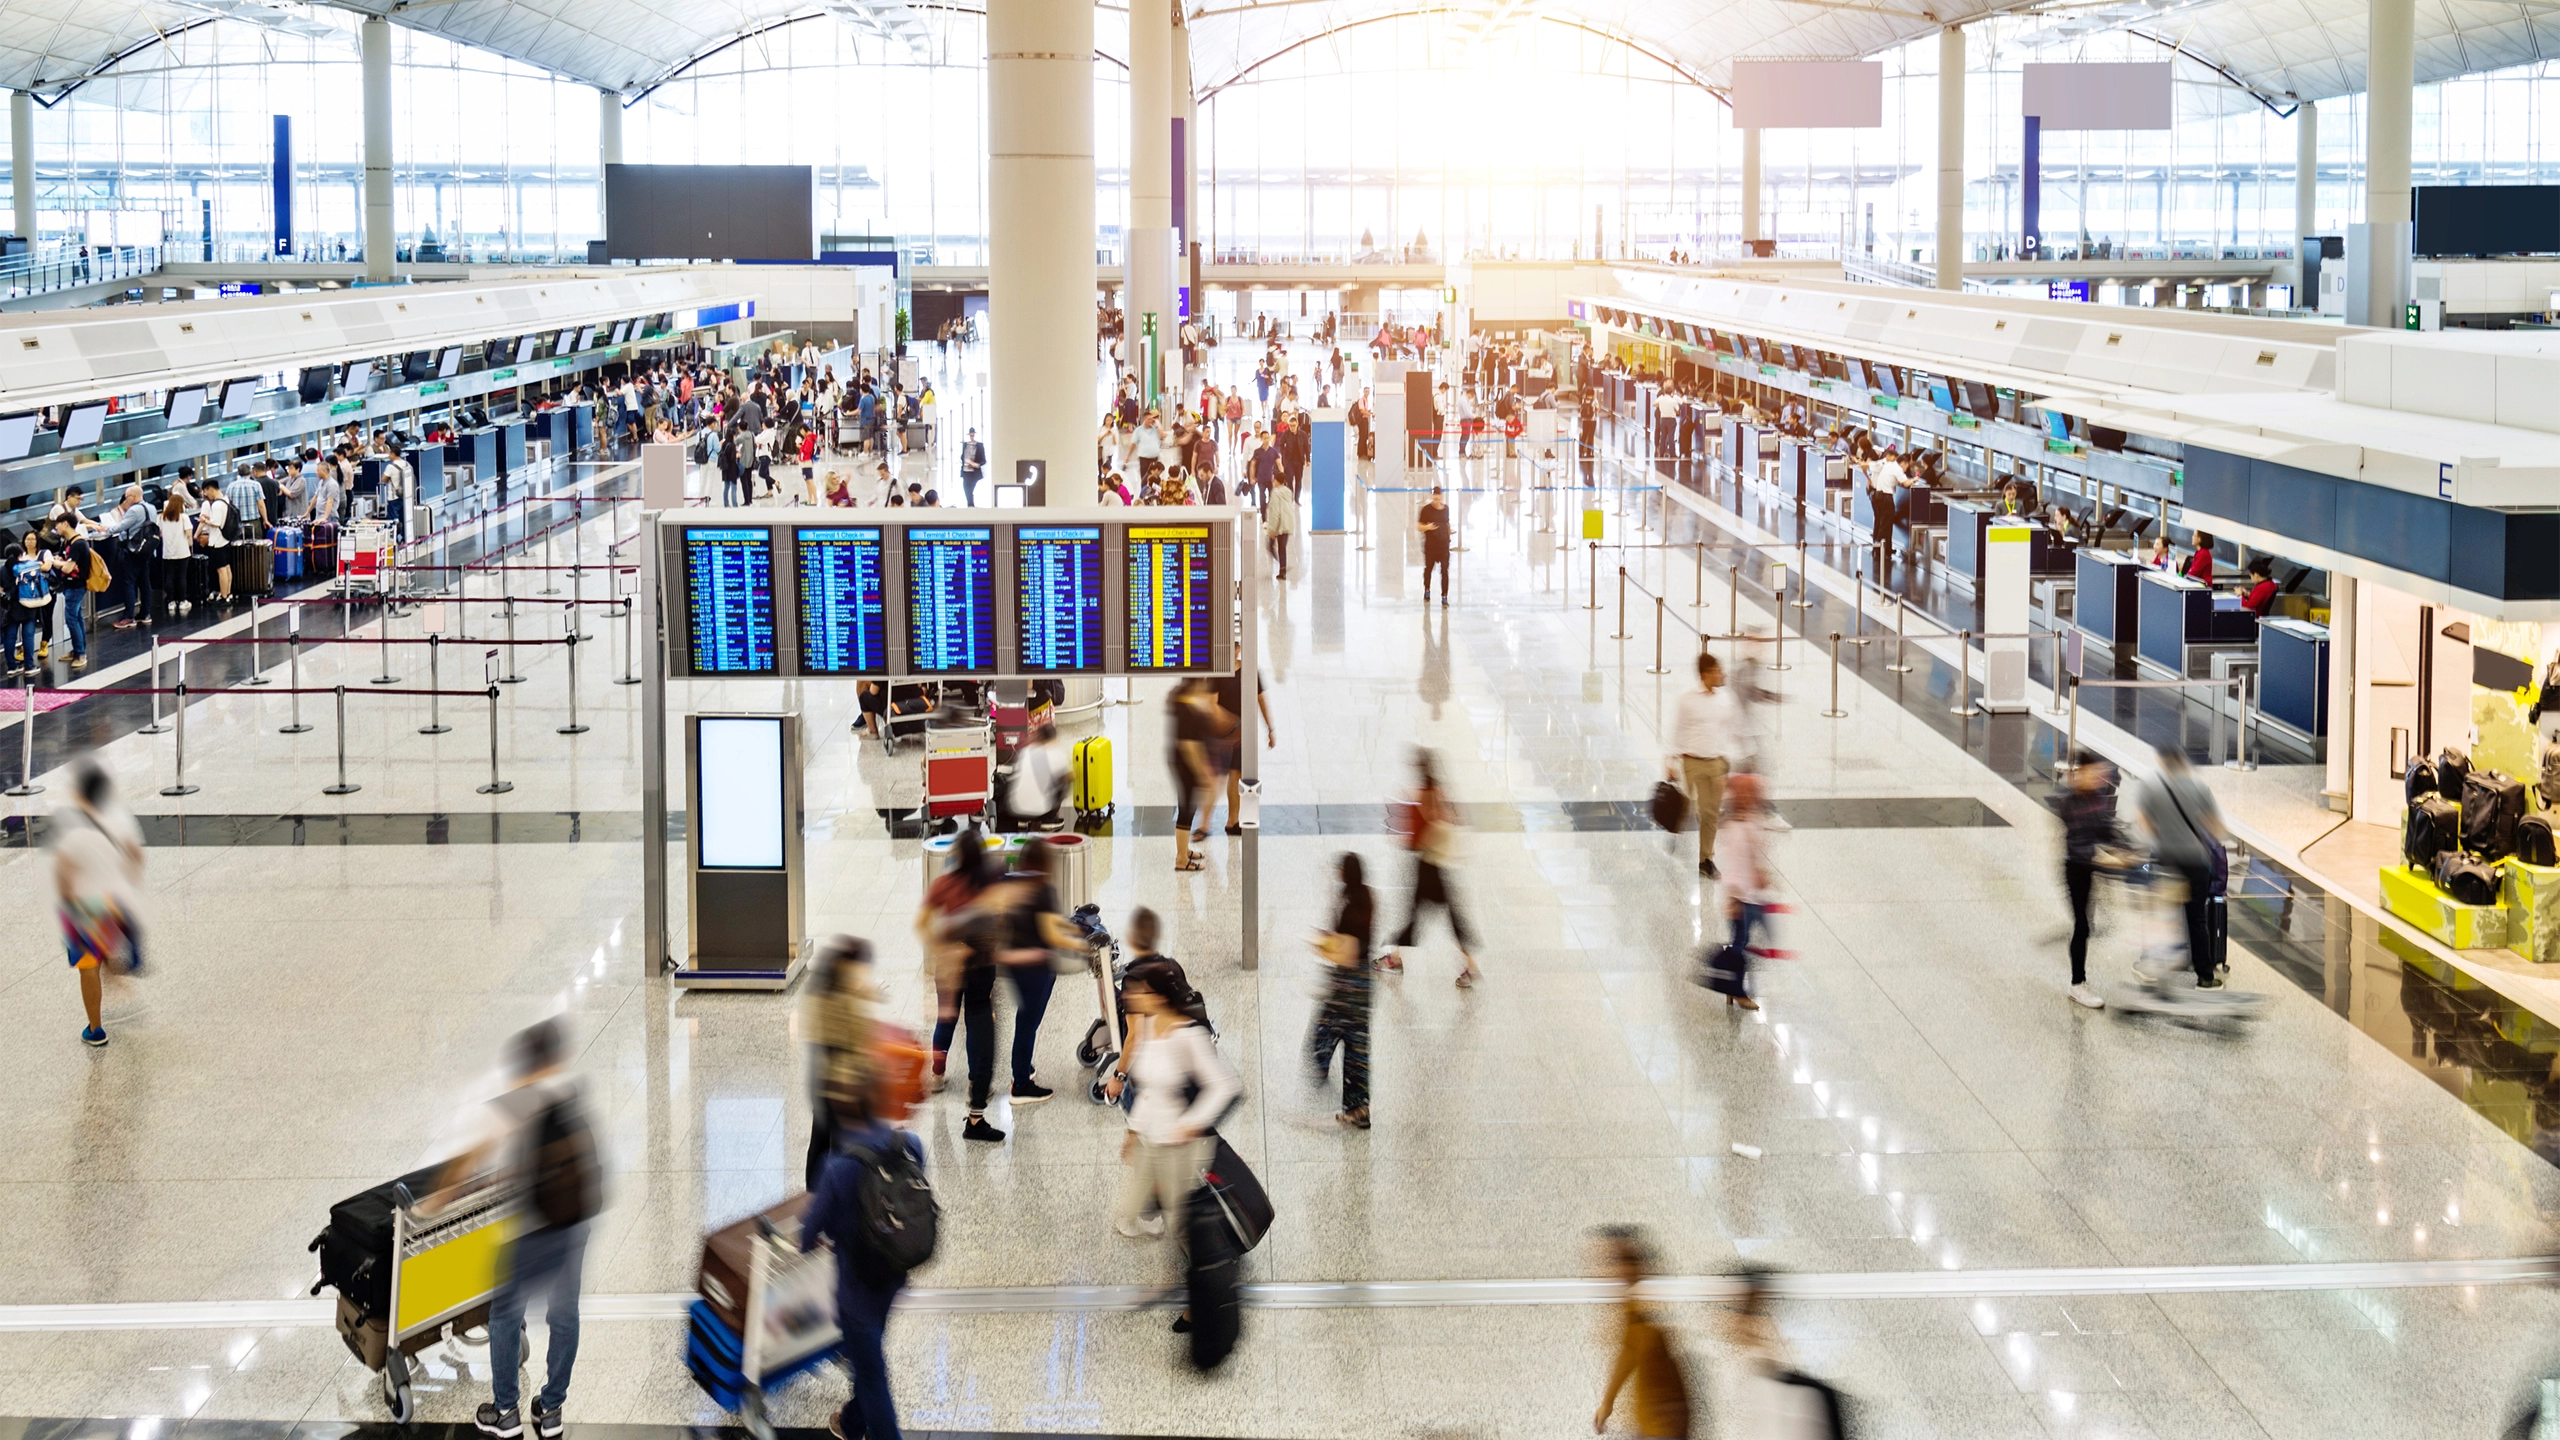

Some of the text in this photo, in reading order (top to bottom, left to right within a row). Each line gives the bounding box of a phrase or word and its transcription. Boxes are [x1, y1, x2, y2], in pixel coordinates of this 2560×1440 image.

[279, 238, 287, 251] F
[2026, 236, 2036, 249] D
[2338, 276, 2344, 292] D
[2439, 462, 2453, 499] E
